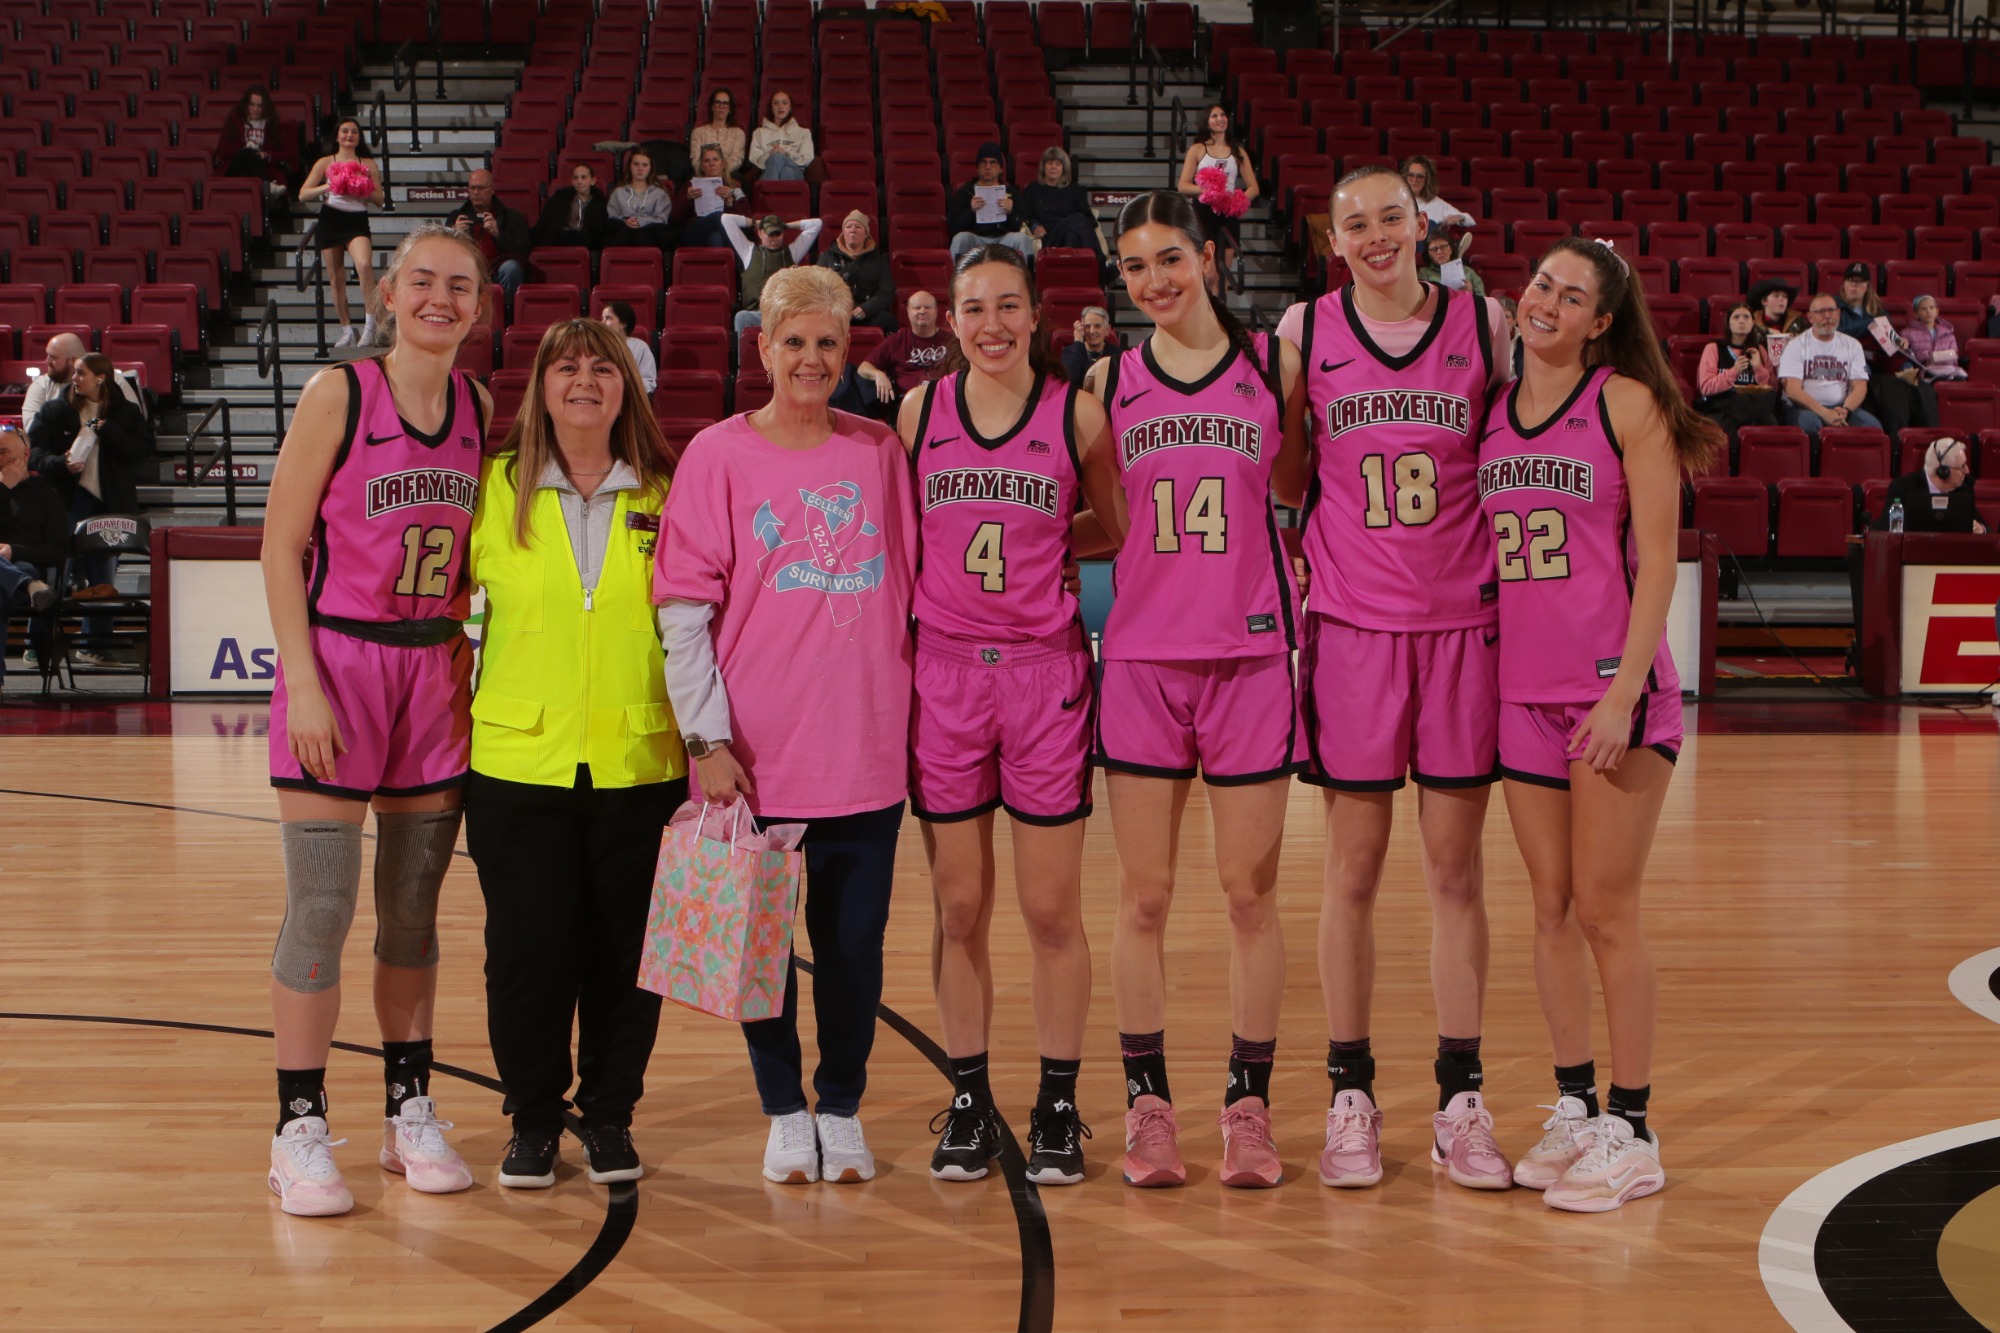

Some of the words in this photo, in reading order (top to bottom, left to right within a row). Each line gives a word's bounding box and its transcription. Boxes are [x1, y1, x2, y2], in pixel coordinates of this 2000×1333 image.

[409, 190, 444, 199] Section
[446, 190, 456, 199] 11
[1330, 391, 1468, 437] LAFAYETTE
[1122, 416, 1260, 467] LAFAYETTE
[194, 467, 239, 477] Sctin
[242, 467, 257, 477] 10
[926, 470, 1058, 515] LAFAYETTE
[1360, 452, 1438, 528] 18
[1478, 458, 1590, 498] AFAYETTE
[807, 494, 851, 522] COLLEEN
[1152, 477, 1228, 554] 14
[393, 524, 455, 599] 12
[812, 524, 837, 568] 12-7-16
[964, 521, 1006, 593] 4
[1493, 508, 1571, 582] 22
[788, 565, 866, 591] SURVIVOR
